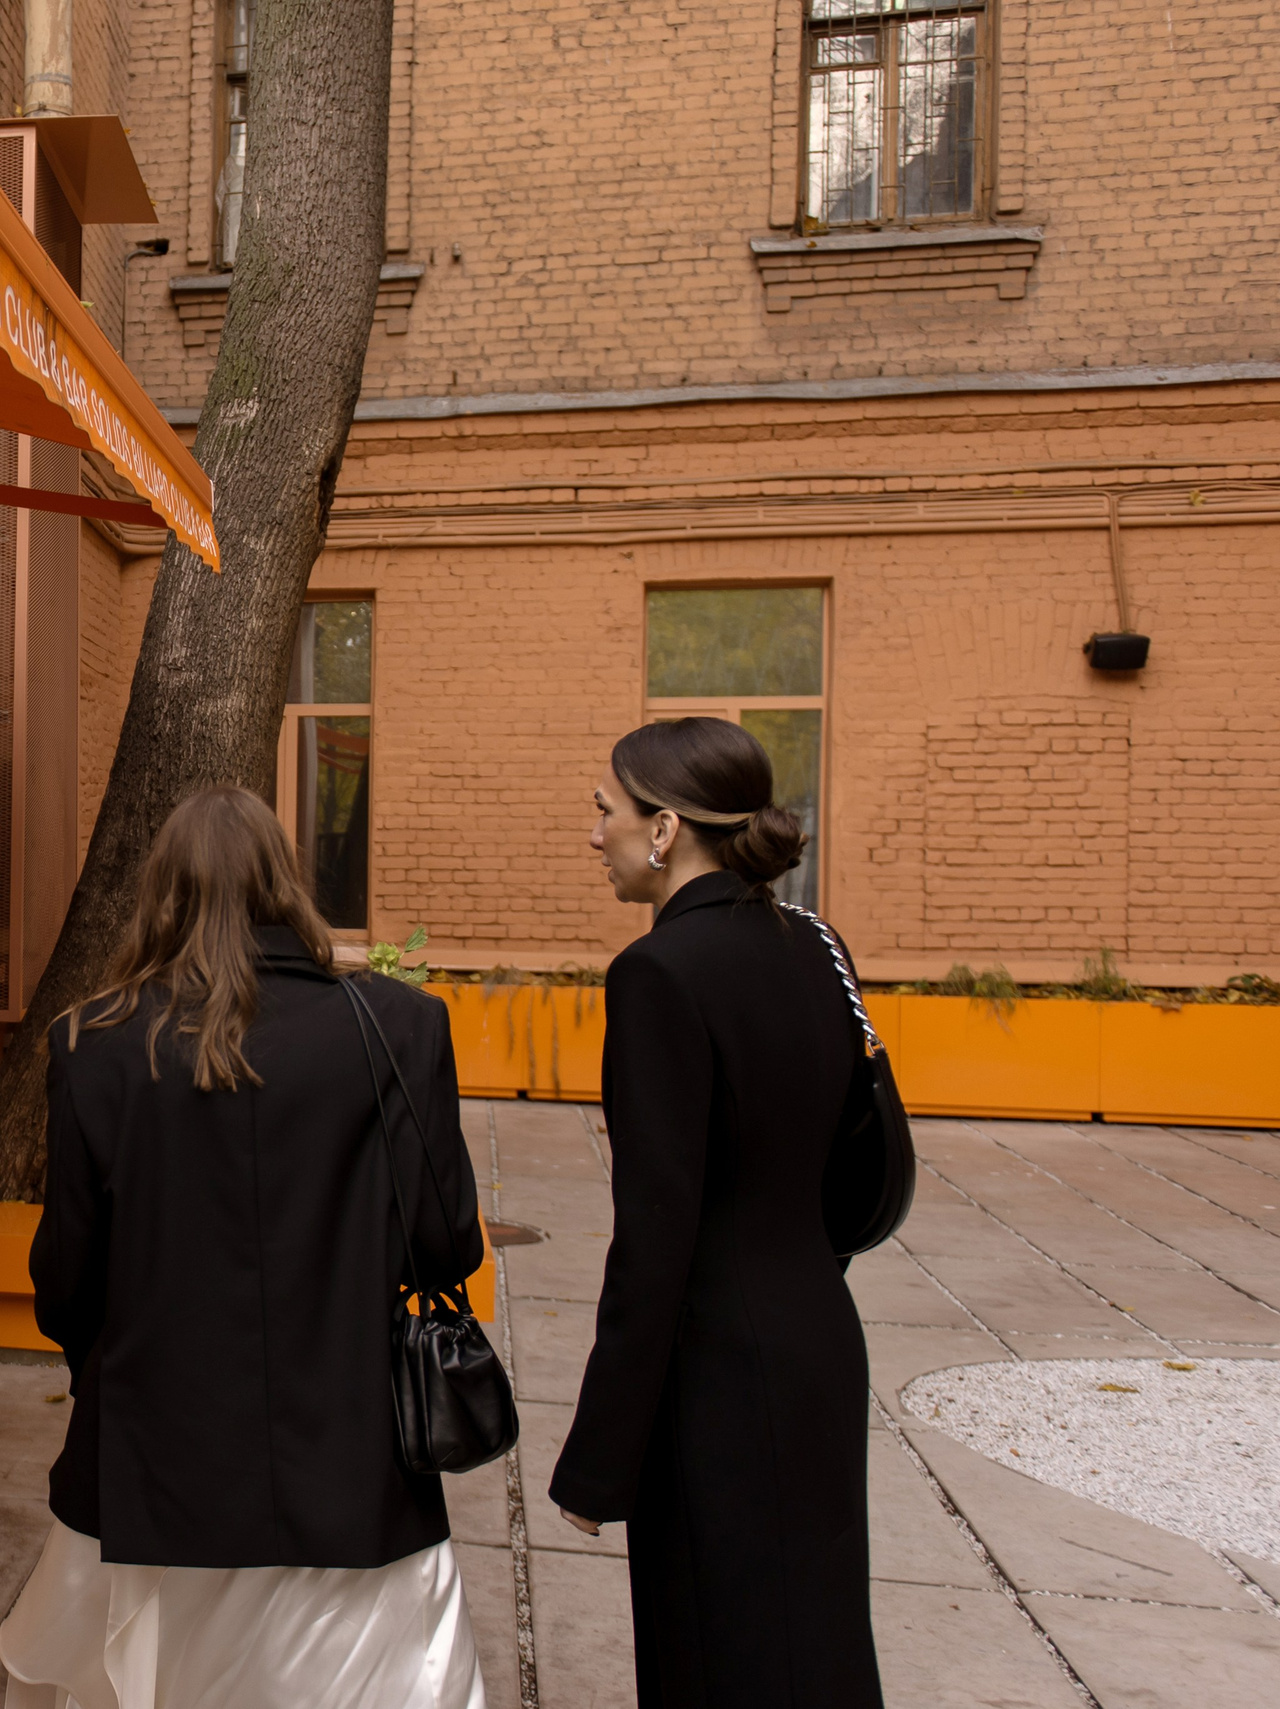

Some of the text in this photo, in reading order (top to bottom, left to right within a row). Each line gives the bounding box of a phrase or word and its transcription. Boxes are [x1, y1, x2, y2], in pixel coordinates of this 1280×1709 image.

[5, 285, 50, 378] CLUB
[50, 339, 63, 392] &
[61, 353, 94, 428] BAR
[91, 388, 132, 471] SOLIDS
[131, 435, 171, 513] BILLIARD
[170, 482, 193, 536] CLUB
[196, 512, 217, 558] BAR
